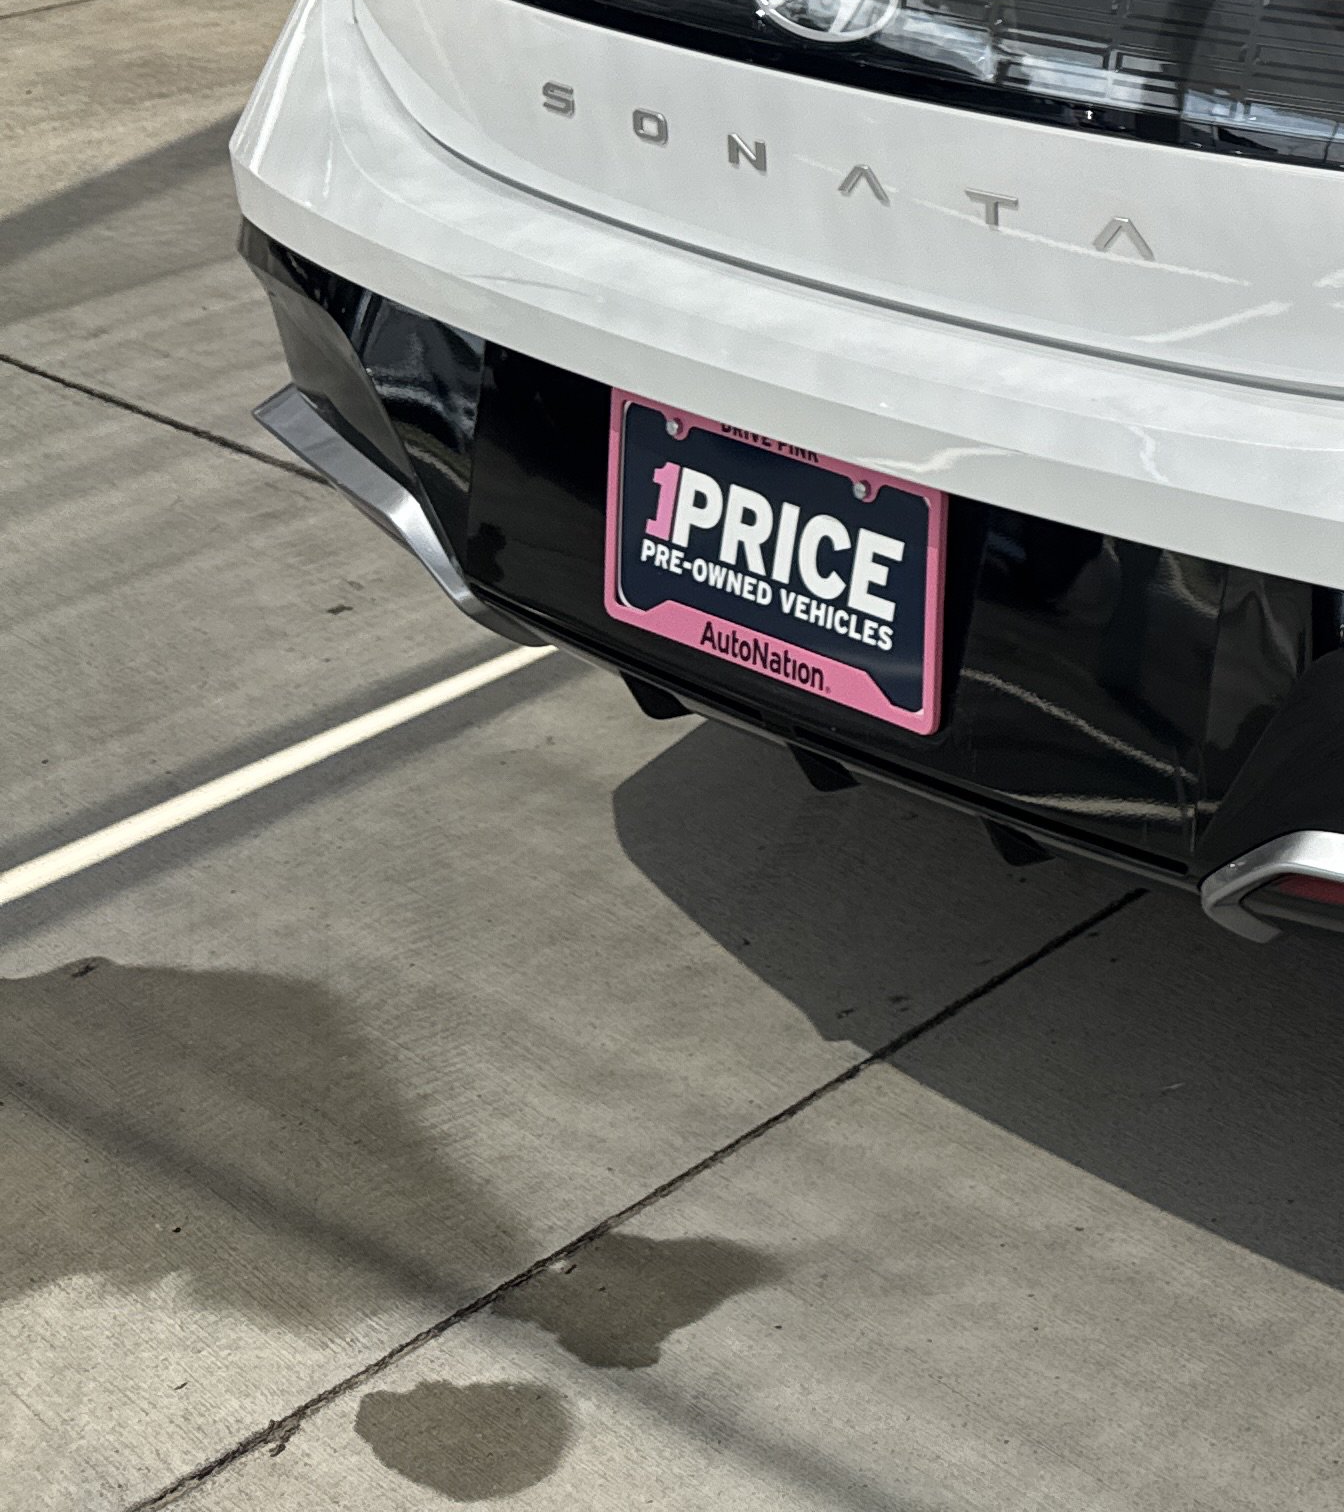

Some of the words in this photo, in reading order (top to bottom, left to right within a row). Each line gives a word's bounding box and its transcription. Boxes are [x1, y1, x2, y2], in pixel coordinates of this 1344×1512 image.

[542, 81, 1155, 261] SONATA
[640, 538, 773, 606] PRE-OWNED
[779, 588, 894, 651] VEHICLES
[645, 461, 905, 622] 1PRICE
[700, 621, 824, 691] AutoNation
